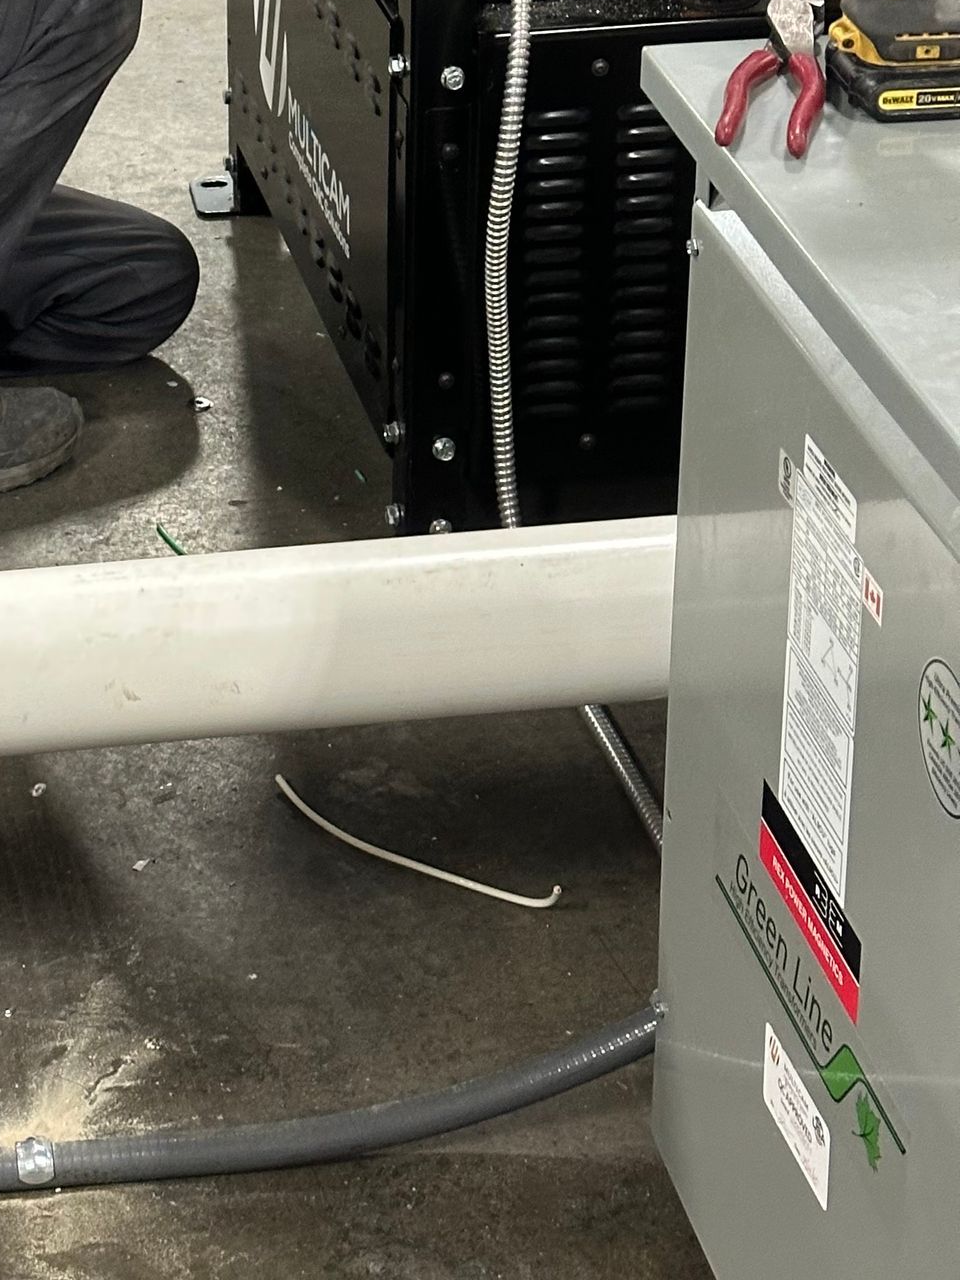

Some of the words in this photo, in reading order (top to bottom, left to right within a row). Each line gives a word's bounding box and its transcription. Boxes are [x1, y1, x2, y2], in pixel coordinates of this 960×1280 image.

[288, 85, 350, 235] MULTICAM
[736, 854, 788, 971] Green
[793, 956, 833, 1052] Line
[772, 855, 785, 883] REX
[785, 877, 807, 922] POWER
[807, 917, 843, 986] MAGNETICS
